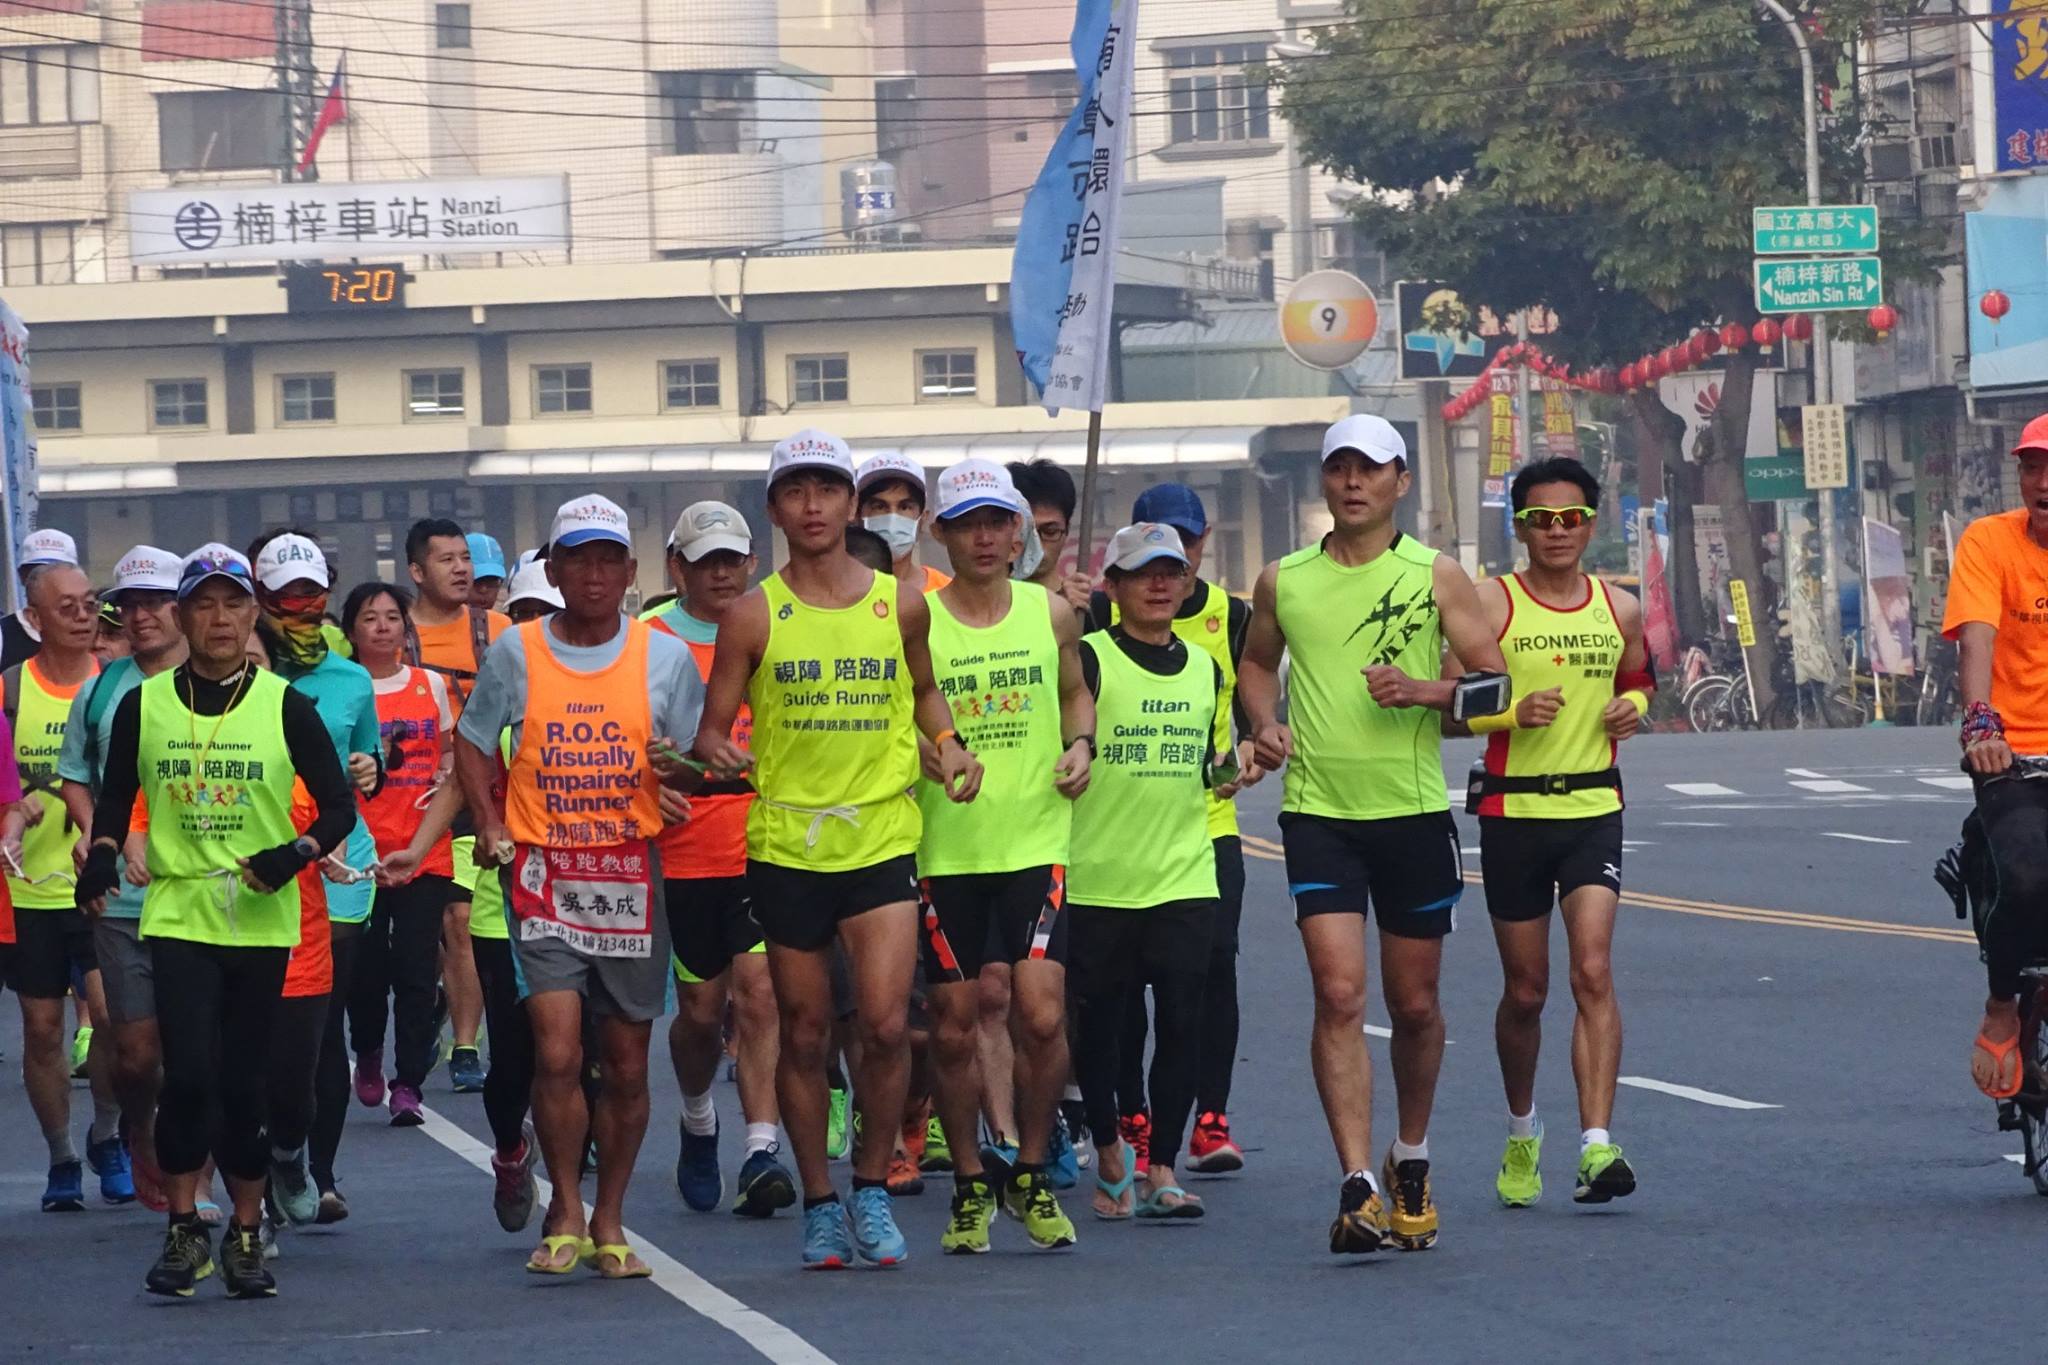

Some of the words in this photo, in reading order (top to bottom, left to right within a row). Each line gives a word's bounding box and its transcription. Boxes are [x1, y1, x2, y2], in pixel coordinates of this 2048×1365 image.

[441, 195, 502, 215] Nanzi
[233, 195, 431, 245] 楠梓車站
[441, 218, 520, 238] Station
[1757, 211, 1855, 231] 國立高應大
[1774, 262, 1862, 286] 楠梓新路
[322, 269, 396, 302] 7:20
[1774, 288, 1820, 306] Nanzih
[1822, 287, 1844, 302] Sin
[1322, 307, 1337, 332] 9
[277, 544, 313, 566] GAP
[951, 655, 984, 667] Guide
[989, 650, 1030, 661] Runner
[774, 659, 822, 683] 視障
[834, 658, 897, 682] 陪跑員
[940, 674, 978, 697] 視障
[989, 665, 1042, 689] 陪跑員
[566, 703, 604, 714] titan
[784, 691, 830, 707] Guide
[836, 690, 892, 705] Runner
[1141, 699, 1190, 713] titan
[546, 722, 628, 743] R.O.C.
[1113, 724, 1158, 737] Guide
[168, 740, 203, 750] Guide
[208, 740, 252, 751] Runner
[1103, 742, 1148, 765] 視障
[540, 746, 636, 770] Visually
[157, 760, 192, 779] 視障
[204, 760, 264, 781] 陪跑員
[535, 769, 642, 793] Impaired
[546, 793, 634, 813] Runner
[547, 818, 640, 847] 視障跑者
[551, 852, 643, 874] 陪跑教練
[561, 892, 639, 917] 吳春成
